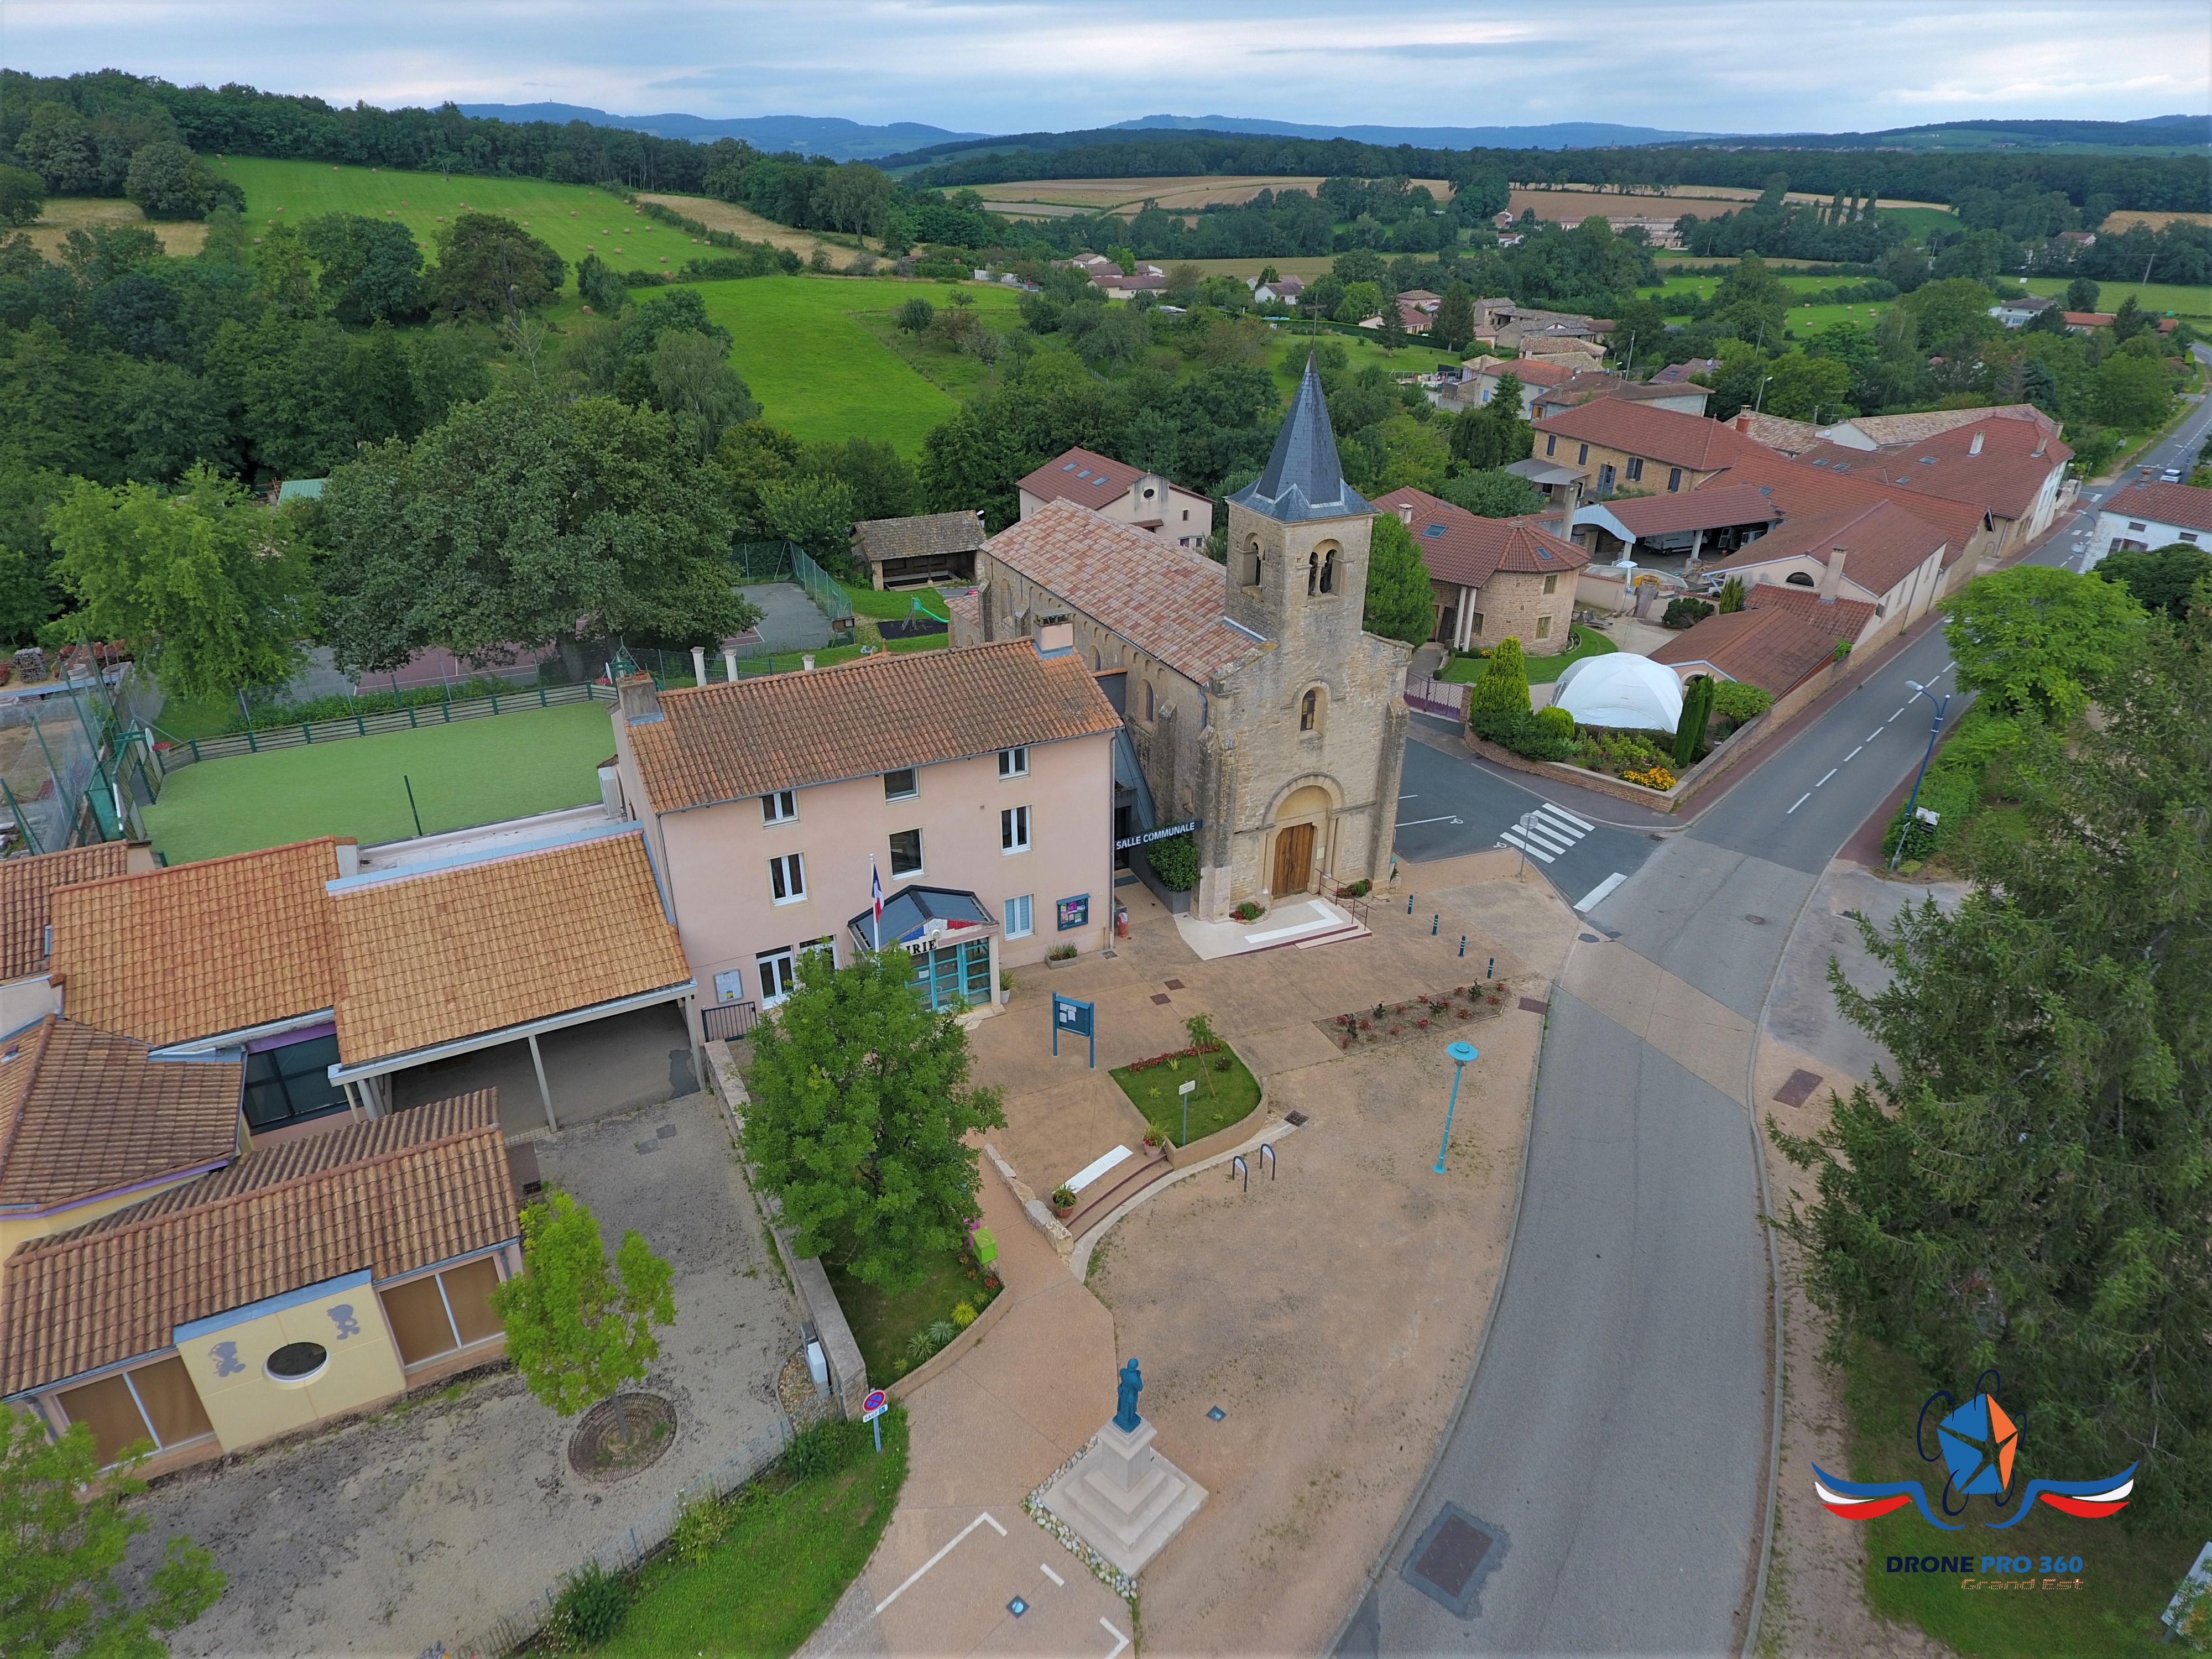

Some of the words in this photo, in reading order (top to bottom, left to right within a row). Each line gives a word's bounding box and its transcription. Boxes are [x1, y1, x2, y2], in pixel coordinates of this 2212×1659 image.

[1116, 836, 1141, 850] SALLE
[1143, 822, 1194, 843] COMMUNALE
[906, 940, 937, 954] IRIE
[864, 1410, 878, 1421] SAUF
